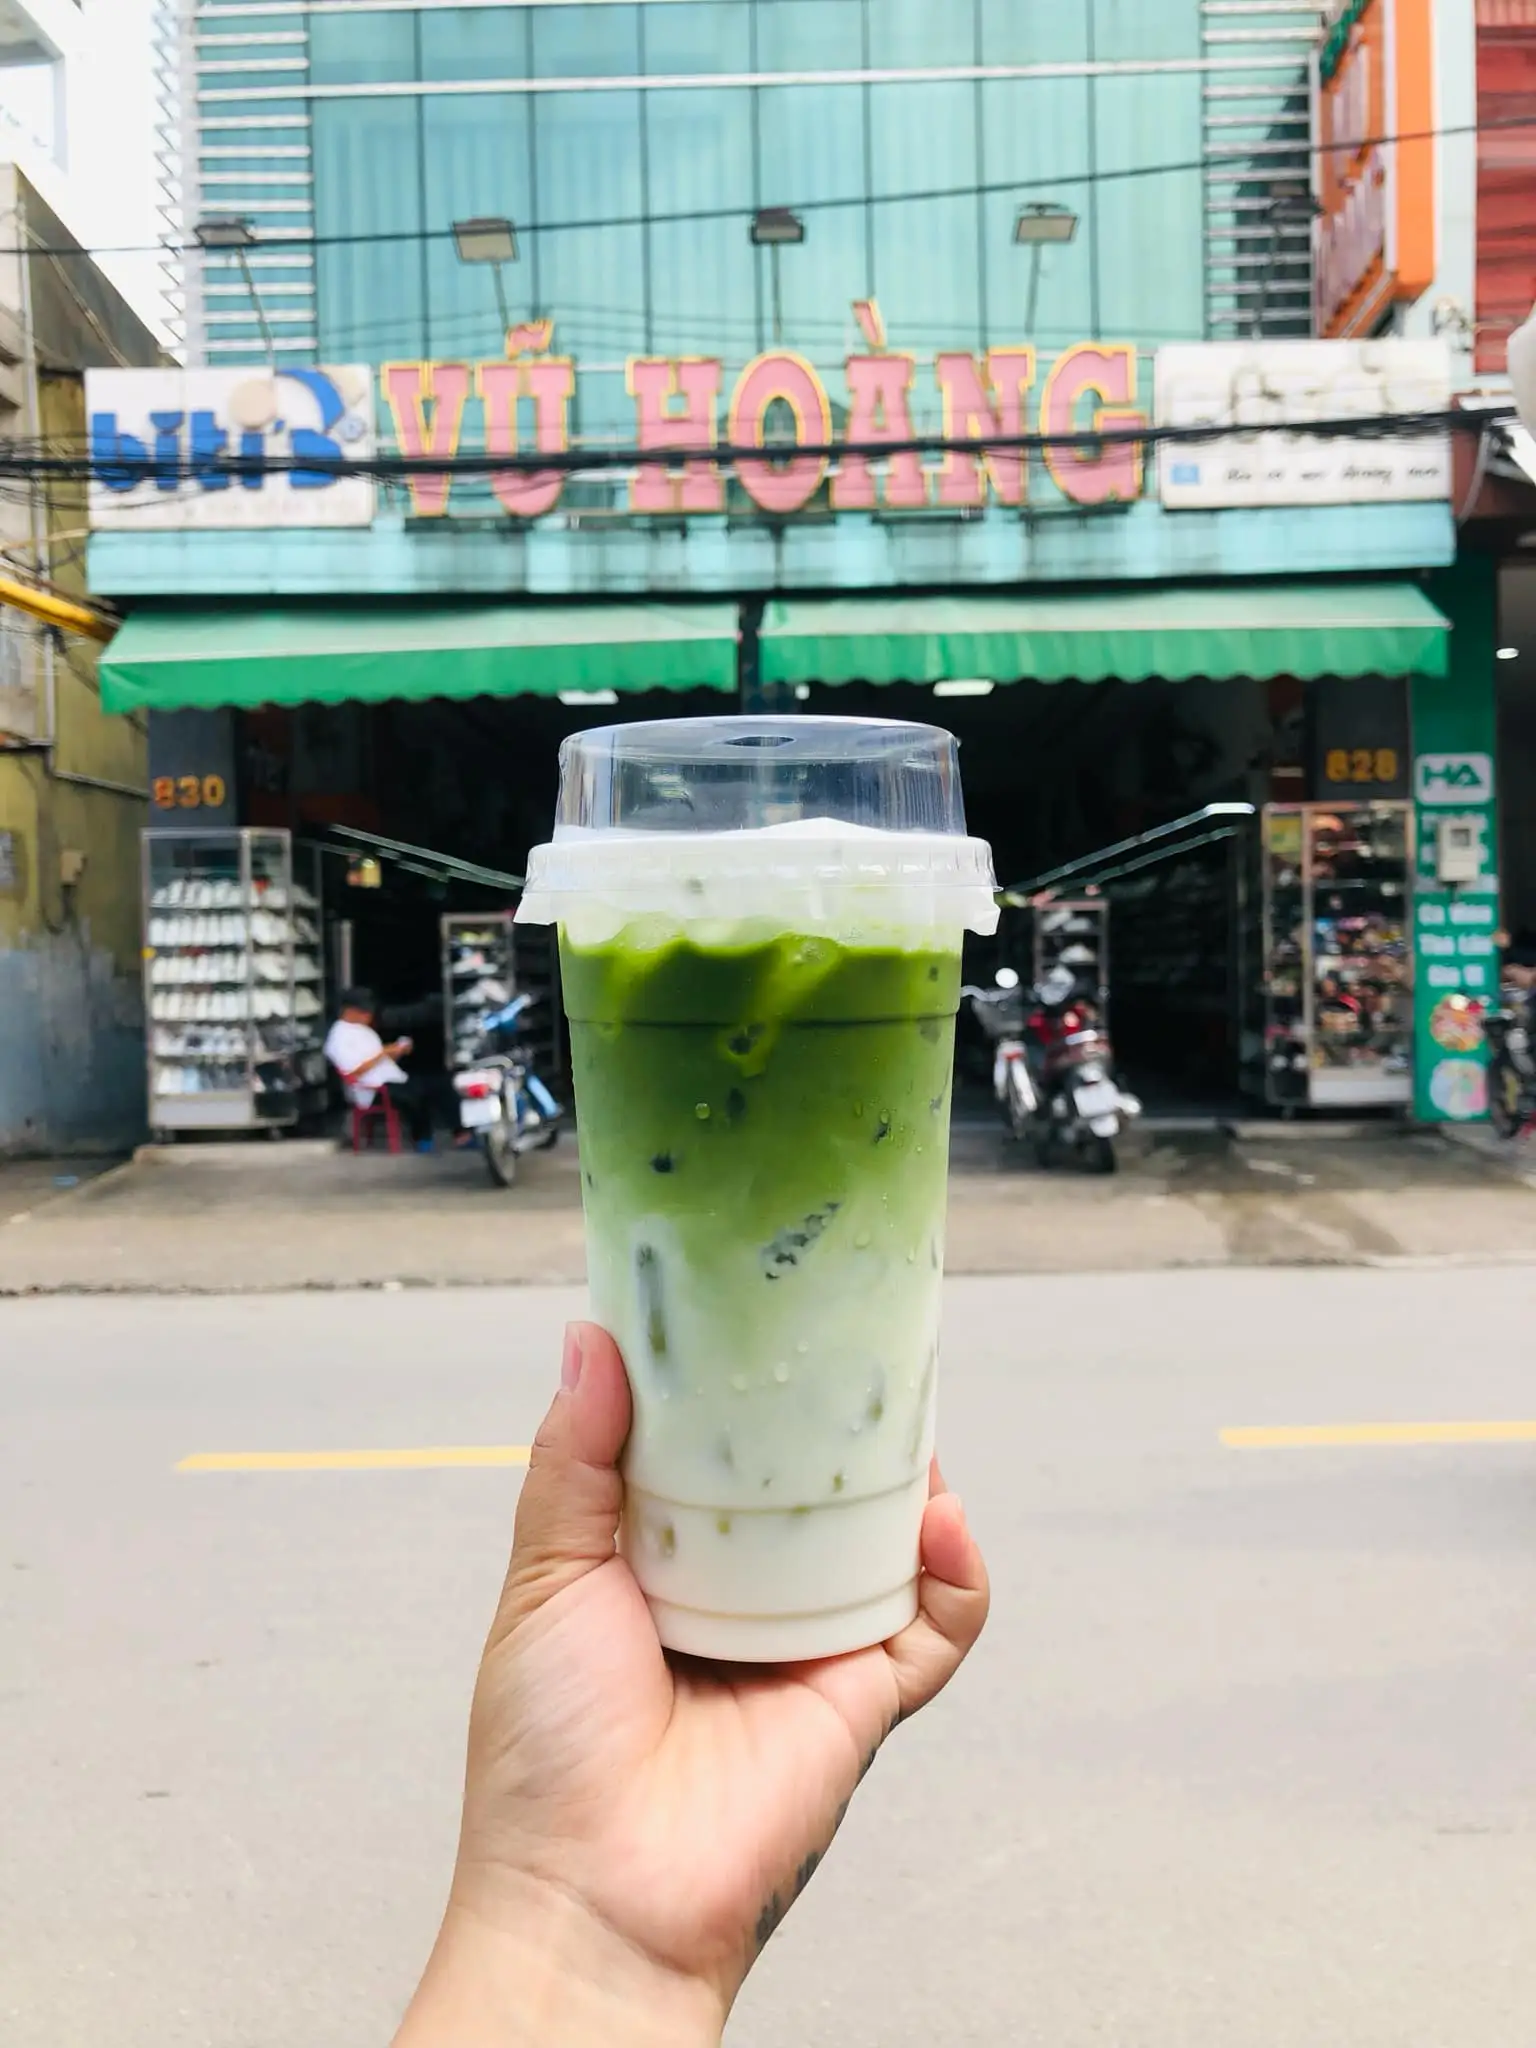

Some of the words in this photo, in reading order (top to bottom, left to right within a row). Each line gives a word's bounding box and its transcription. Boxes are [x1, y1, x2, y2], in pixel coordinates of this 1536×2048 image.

[381, 319, 575, 517] VŨ
[626, 299, 1146, 513] HOÀNG
[152, 773, 225, 810] 830
